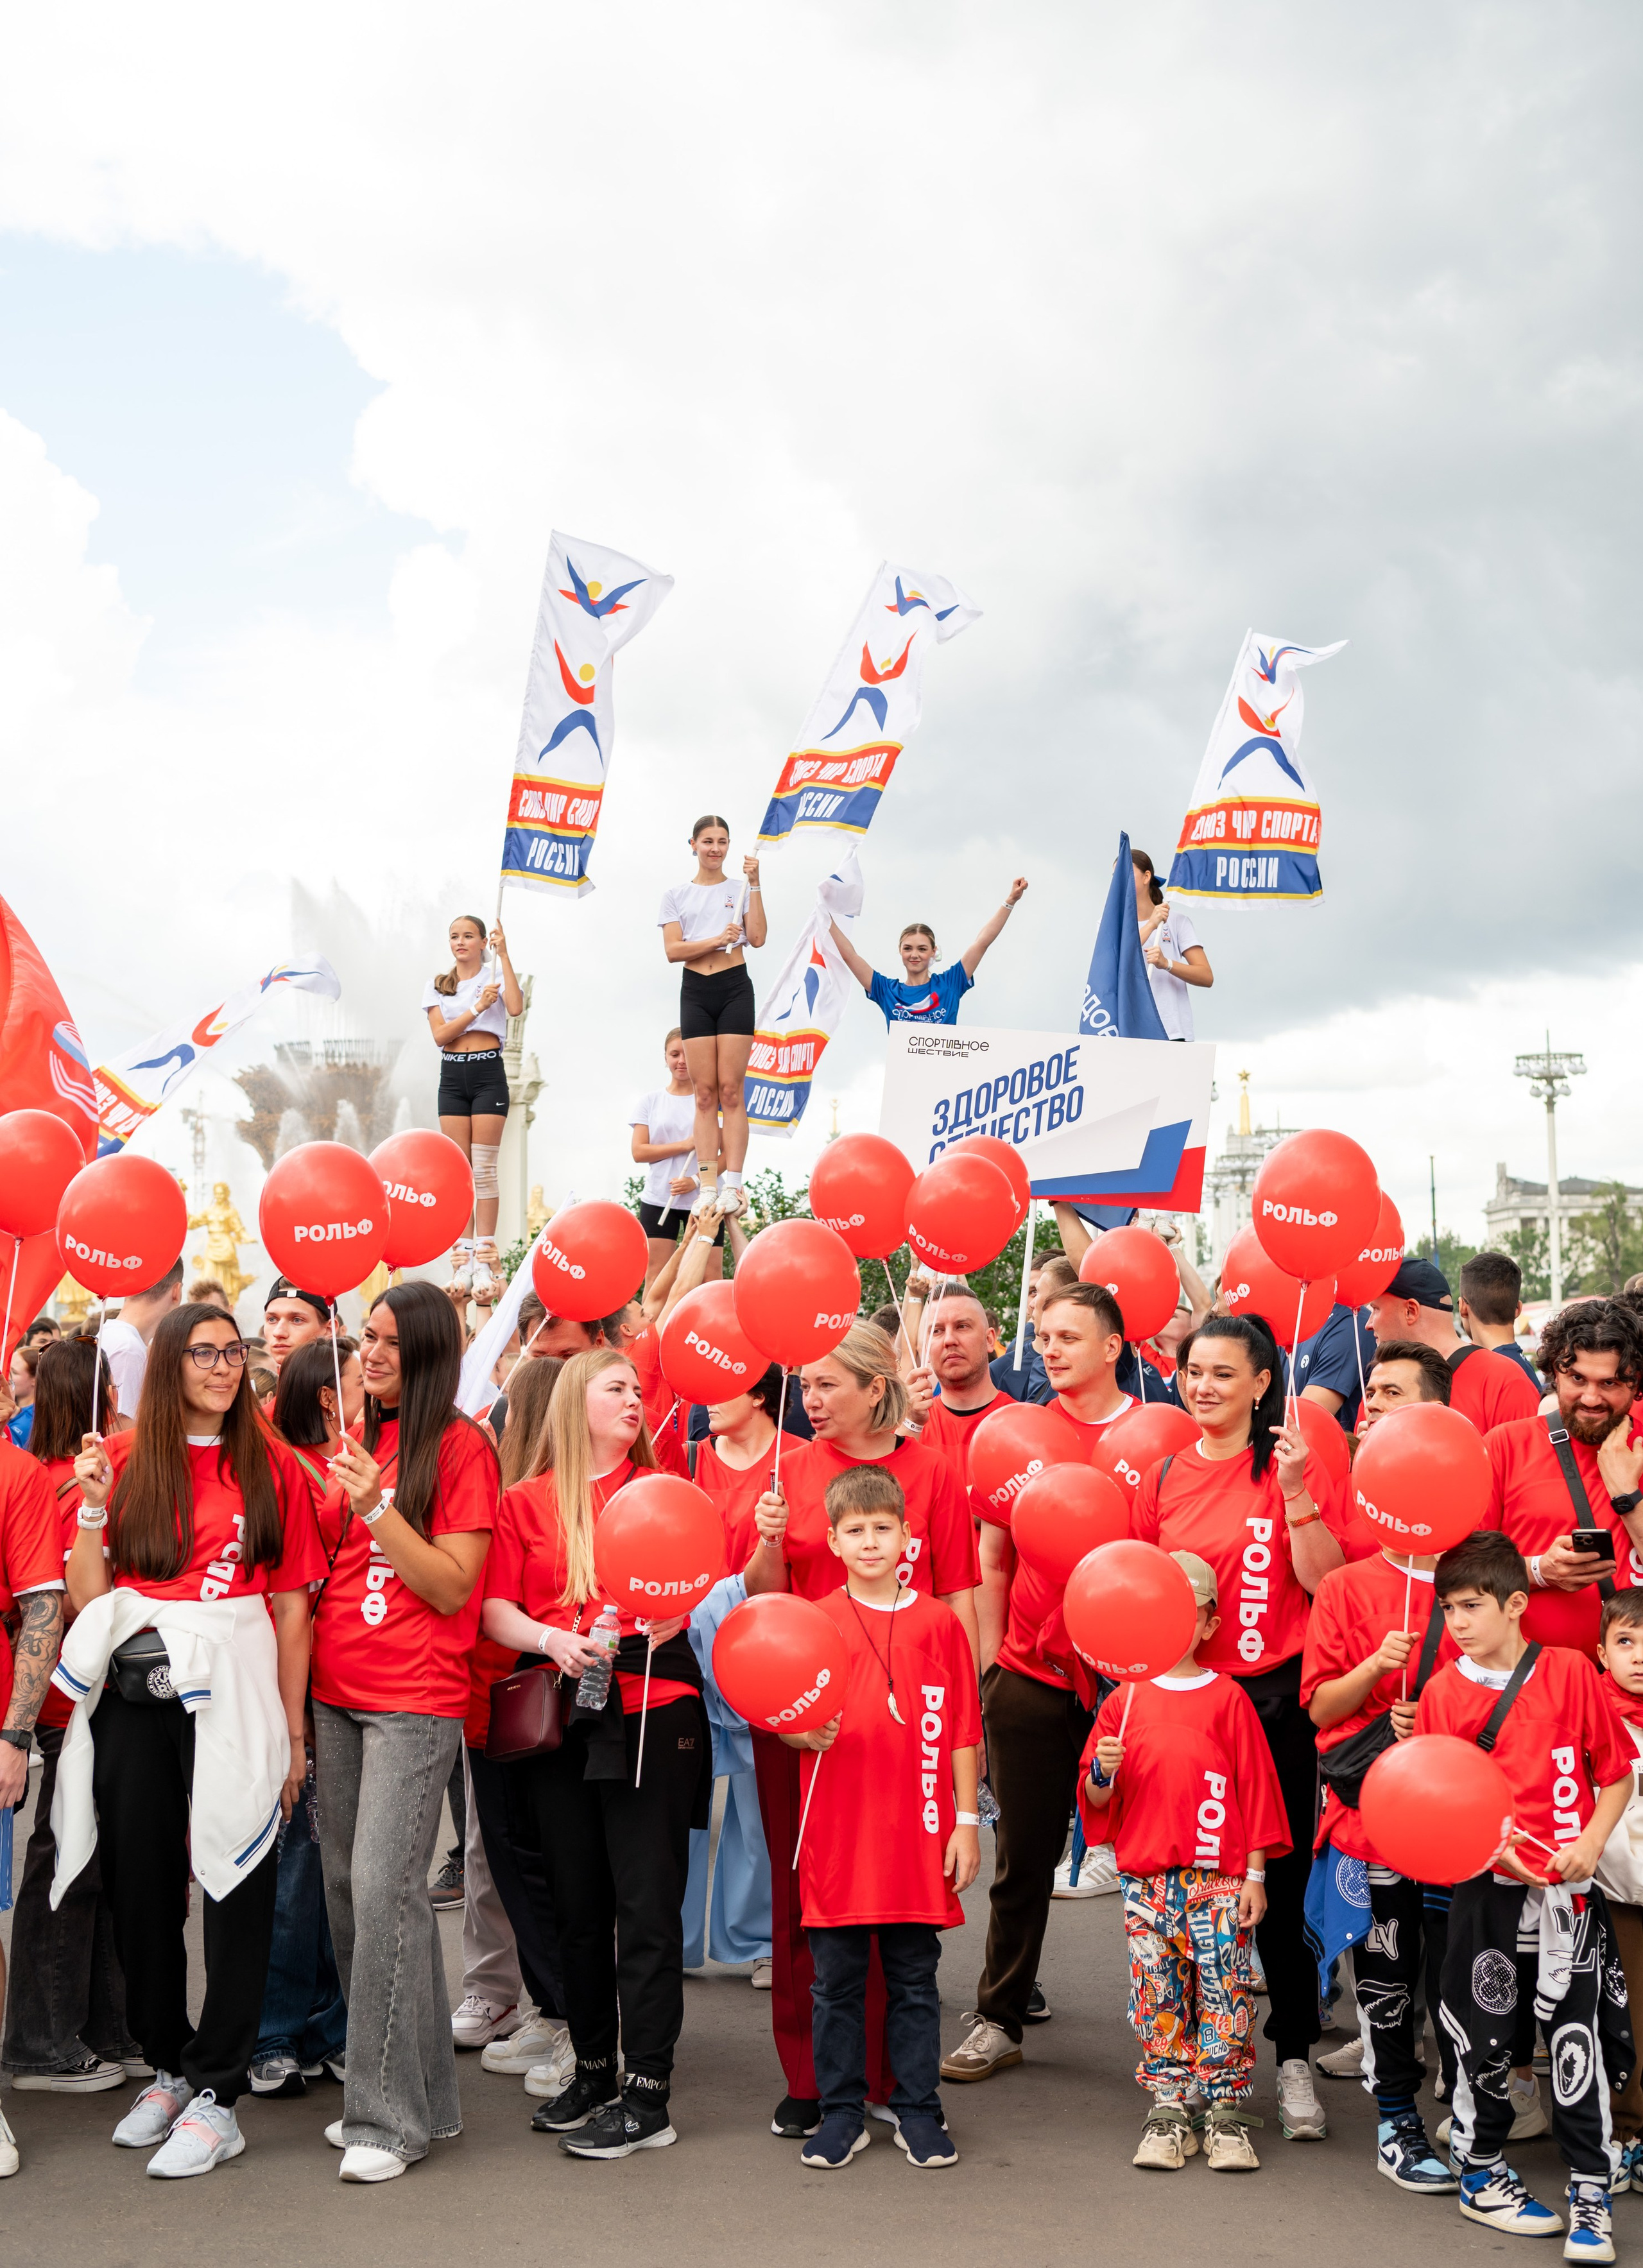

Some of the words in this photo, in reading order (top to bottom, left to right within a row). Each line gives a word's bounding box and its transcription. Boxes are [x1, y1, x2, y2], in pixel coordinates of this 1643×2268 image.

[841, 753, 888, 784] СПОРТА
[1261, 810, 1318, 844] СПОРТА
[1216, 856, 1278, 888] РОССИИ
[441, 1052, 466, 1061] NIKE
[467, 1051, 496, 1061] PRO
[908, 1047, 969, 1058] ШЕСТВИЕ
[933, 1045, 1081, 1137] ЗДОРОВОЕ
[383, 1180, 436, 1207] ОЛЬФ
[295, 1218, 373, 1242] РОЛЬФ
[1262, 1199, 1338, 1227] РОЛЬФ
[65, 1233, 142, 1269] РОЛЬФ
[539, 1233, 585, 1280] РОЛЬФ
[909, 1223, 968, 1262] РОЛЬФ
[684, 1331, 746, 1375] РОЛЬФ
[988, 1459, 1042, 1508] РОЛЬФ
[1357, 1490, 1432, 1536] РОЛЬФ
[629, 1574, 709, 1596] РОЛЬФ
[1237, 1517, 1273, 1662] РОЛЬФ
[765, 1669, 830, 1726] РОЛЬФ
[678, 1738, 695, 1746] EA7
[921, 1685, 945, 1834] РОЛЬФ
